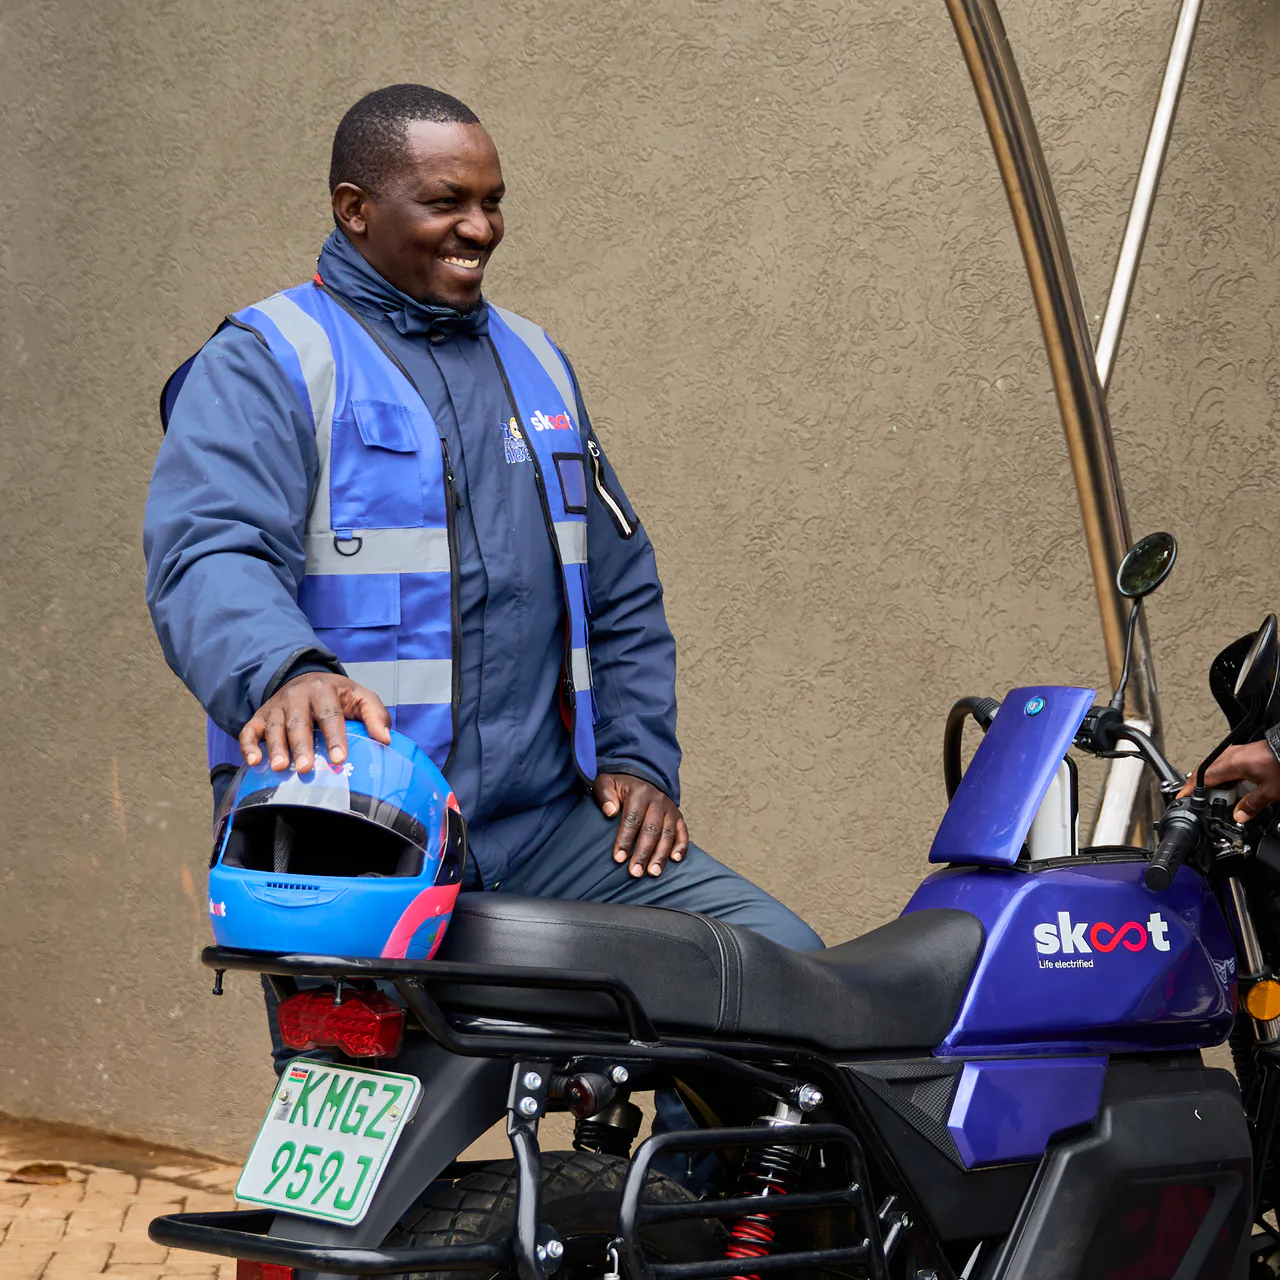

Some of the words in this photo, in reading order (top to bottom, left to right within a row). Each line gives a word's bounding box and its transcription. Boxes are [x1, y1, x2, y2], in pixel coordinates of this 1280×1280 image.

[530, 410, 573, 431] skoot
[1034, 911, 1171, 954] skoot
[1039, 960, 1054, 969] Life
[1055, 959, 1094, 968] electrified
[289, 1070, 404, 1140] KMGZ
[263, 1140, 373, 1211] 959J
